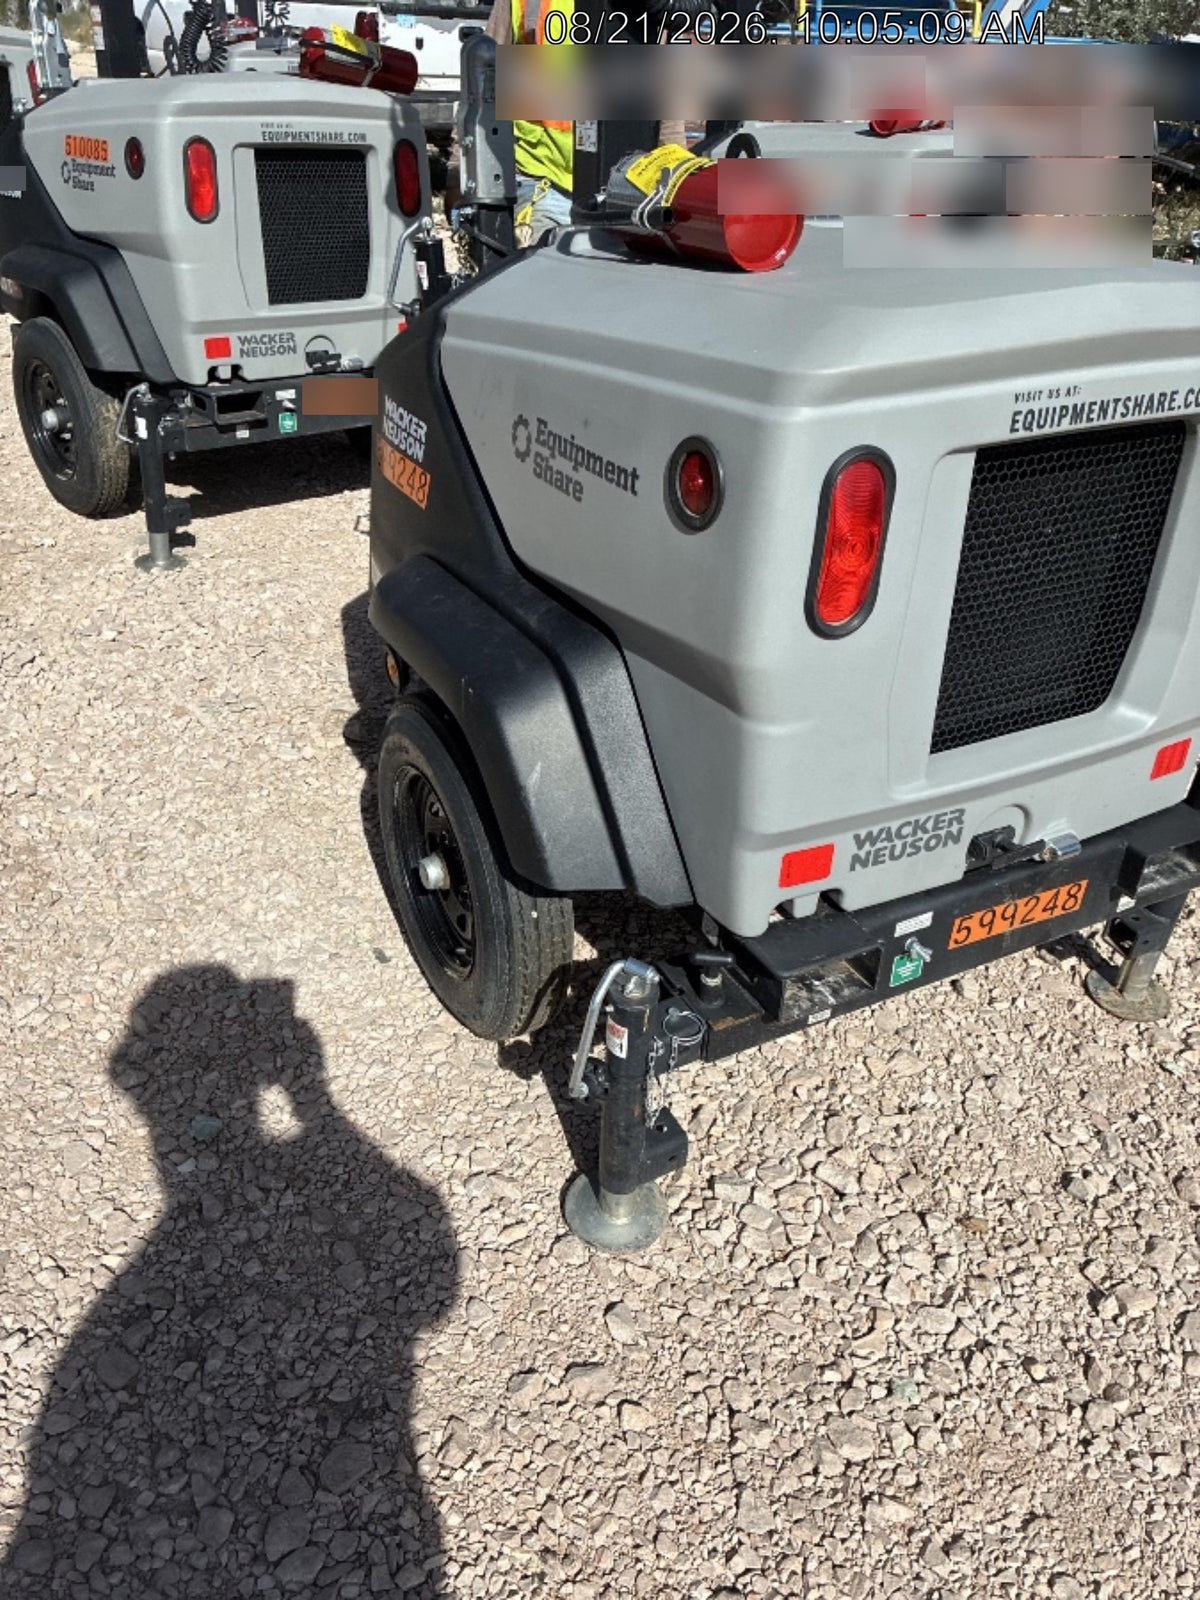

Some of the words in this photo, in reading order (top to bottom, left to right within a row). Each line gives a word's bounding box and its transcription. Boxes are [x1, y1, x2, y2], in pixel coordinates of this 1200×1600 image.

[261, 130, 367, 143] EQUIPMENTSHARE.COM
[237, 331, 296, 347] WACKER
[239, 344, 298, 359] NEUSON
[1014, 389, 1043, 404] VISIT
[1064, 385, 1083, 398] AT:
[383, 415, 426, 463] NEUSON
[384, 394, 428, 445] WACKER
[378, 444, 428, 504] 9248
[532, 451, 585, 502] Share
[534, 417, 639, 496] Equipment
[848, 826, 965, 872] NEUSON
[852, 808, 966, 851] WACKER
[953, 883, 1084, 945] 599248
